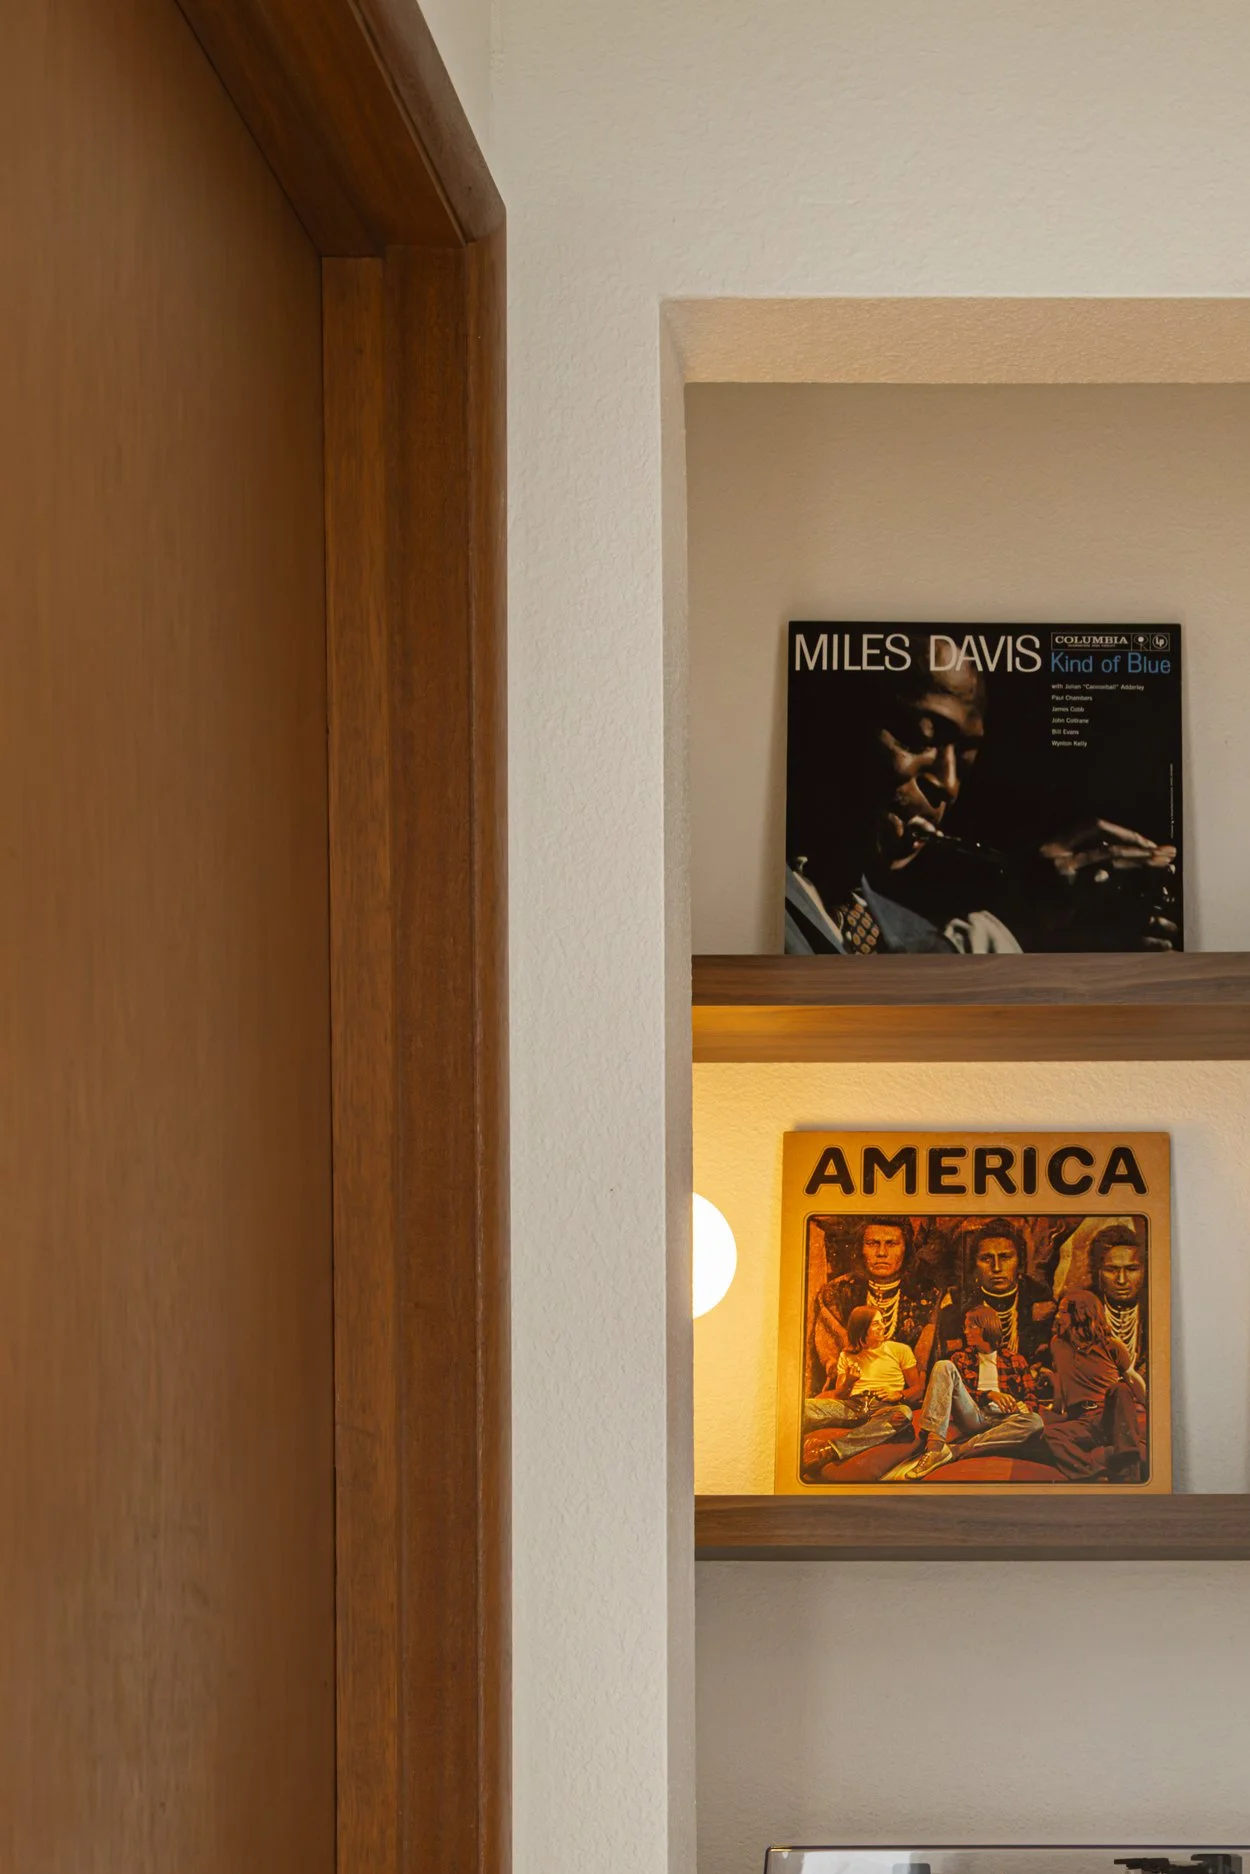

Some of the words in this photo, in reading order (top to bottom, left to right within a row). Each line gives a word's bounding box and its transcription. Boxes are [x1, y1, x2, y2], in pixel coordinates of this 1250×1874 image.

[1055, 635, 1128, 645] COLUMBIA
[794, 633, 912, 672] MILES
[929, 634, 1042, 673] DAVIS
[1051, 651, 1093, 673] Kind
[1101, 655, 1121, 673] of
[1128, 652, 1171, 674] Blue
[1073, 740, 1088, 748] Kelly
[805, 1146, 1148, 1196] AMERICA
